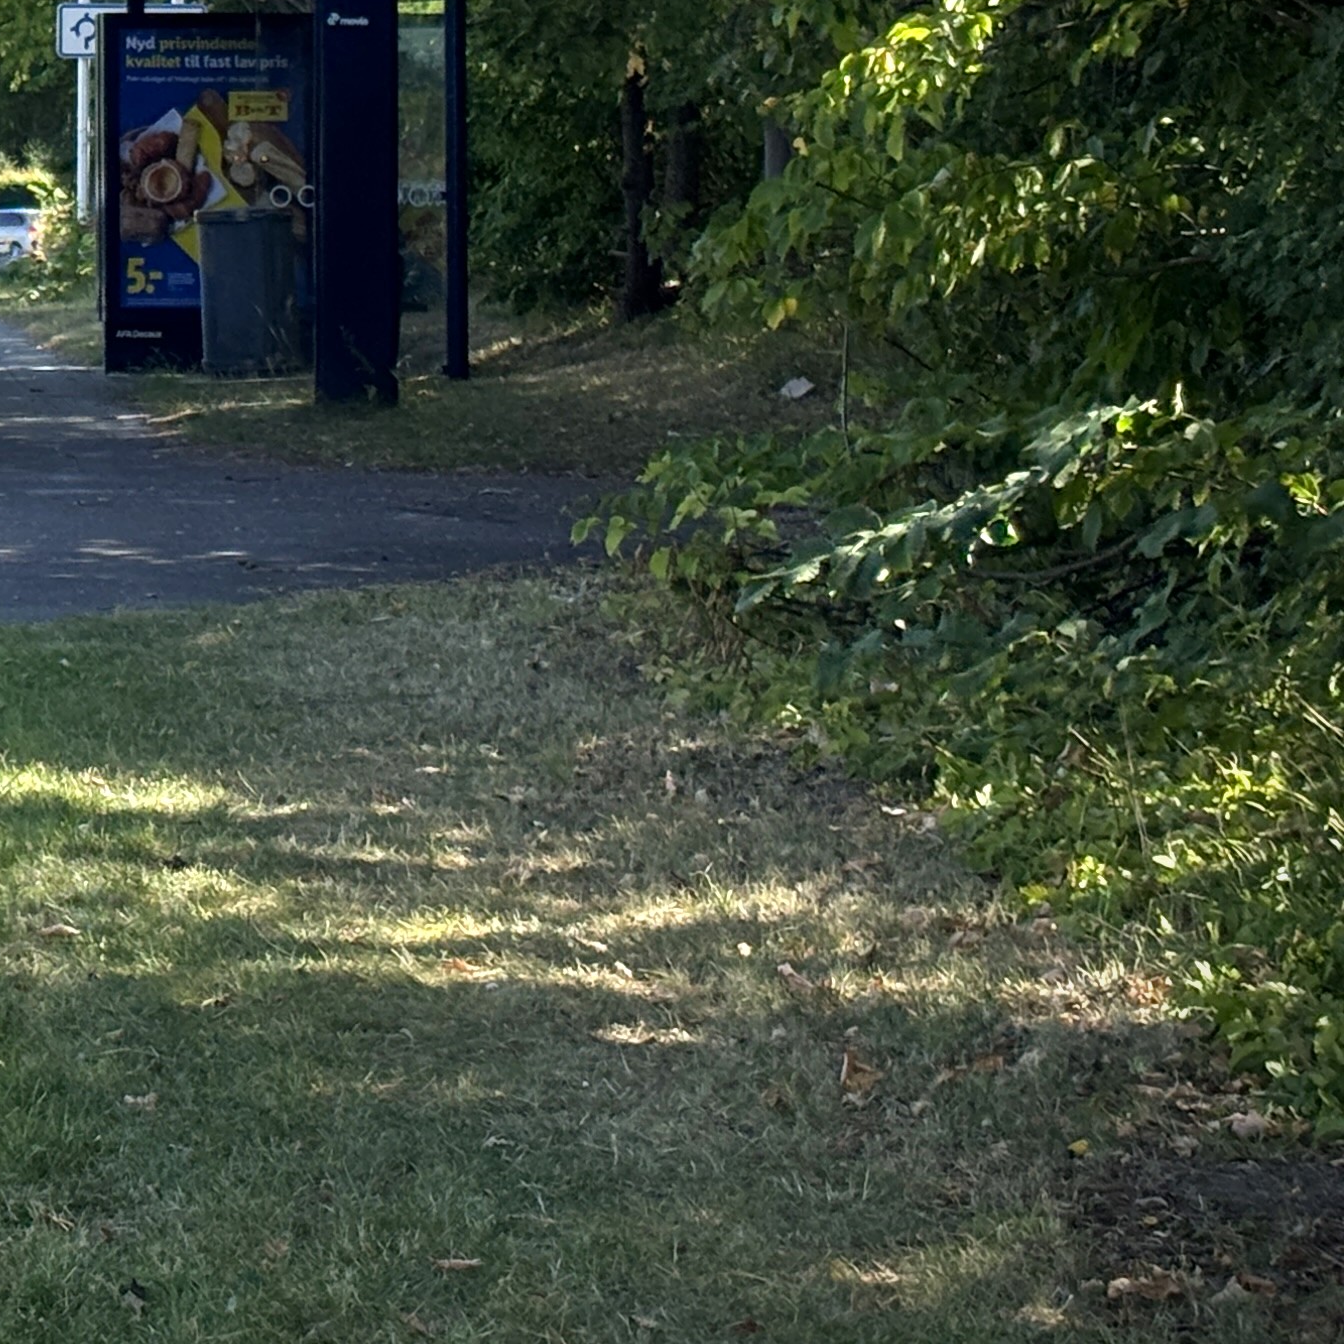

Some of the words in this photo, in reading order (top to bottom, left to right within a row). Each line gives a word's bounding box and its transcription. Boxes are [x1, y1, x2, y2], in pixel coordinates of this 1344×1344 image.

[126, 36, 156, 52] Nyd
[160, 36, 257, 51] prisvindende
[125, 54, 181, 69] kvalitet
[184, 54, 201, 69] til
[203, 54, 232, 69] fast
[234, 54, 257, 69] lav
[260, 55, 289, 71] pris
